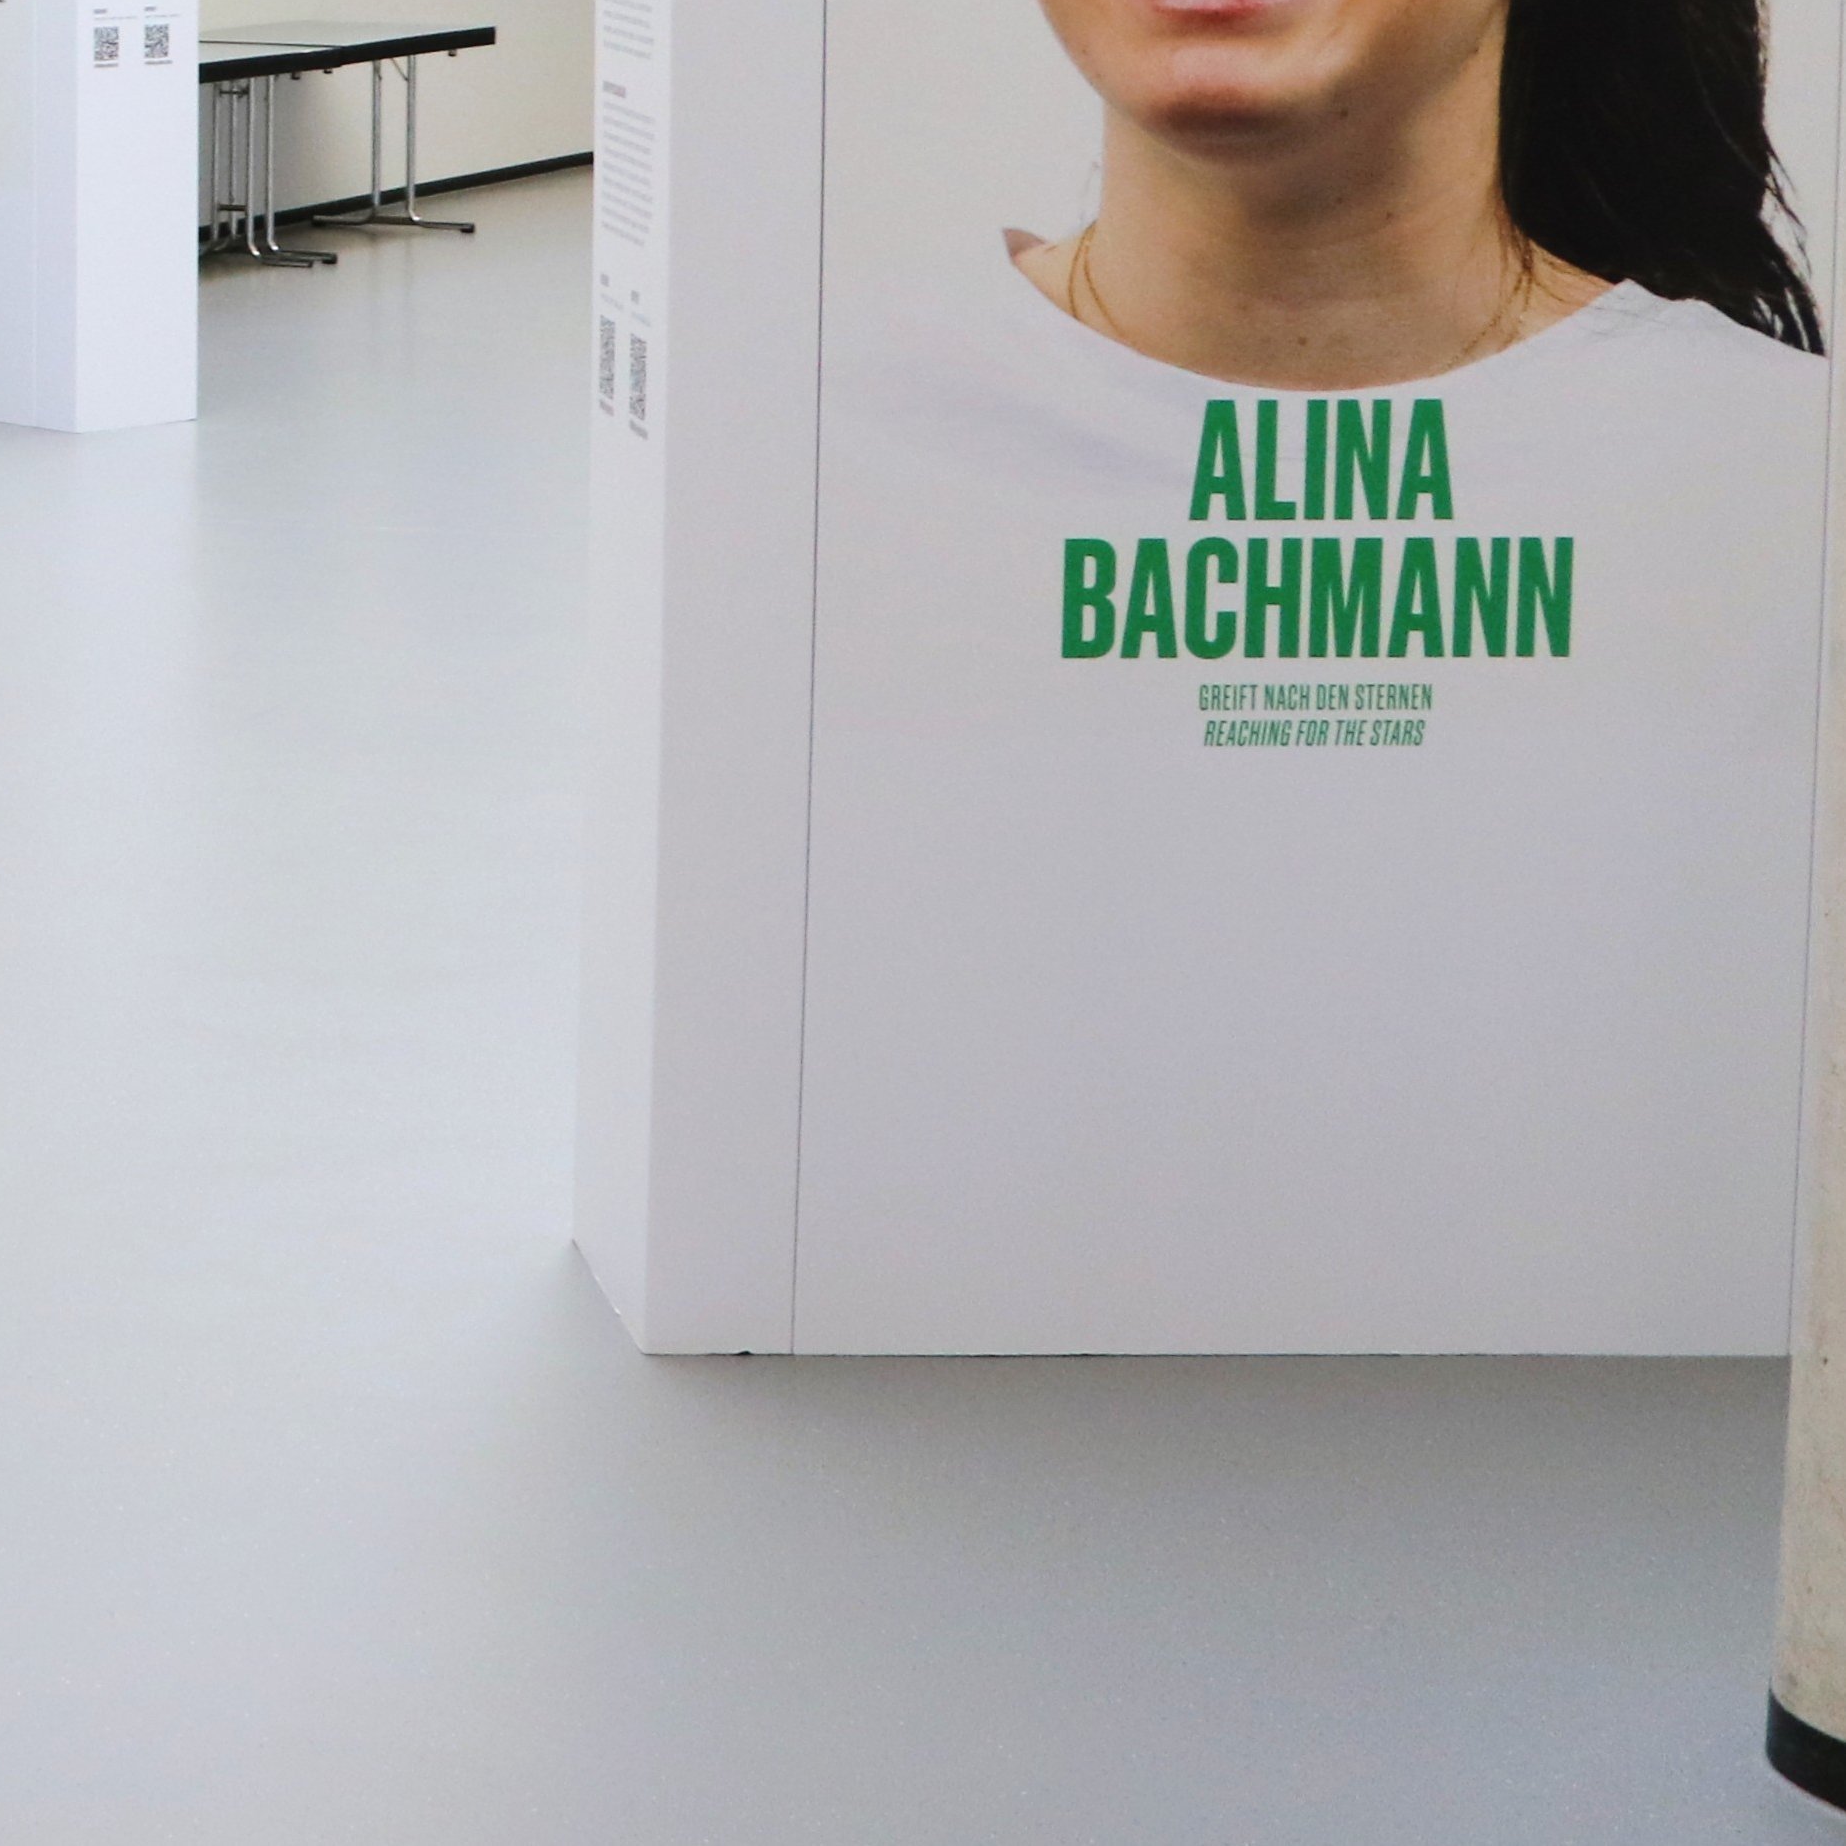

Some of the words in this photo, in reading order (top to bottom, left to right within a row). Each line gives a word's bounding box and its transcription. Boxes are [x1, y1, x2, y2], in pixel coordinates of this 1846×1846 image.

[1188, 399, 1453, 521] ALINA
[1061, 536, 1574, 659] BACHMANN
[1199, 684, 1258, 711] GREIFT
[1264, 684, 1311, 711] NACH
[1316, 684, 1349, 711] DEN
[1355, 684, 1433, 710] STERNEN
[1204, 720, 1292, 746] REACHING
[1295, 720, 1331, 746] FOR
[1334, 720, 1370, 746] THE
[1370, 720, 1426, 746] STARS
